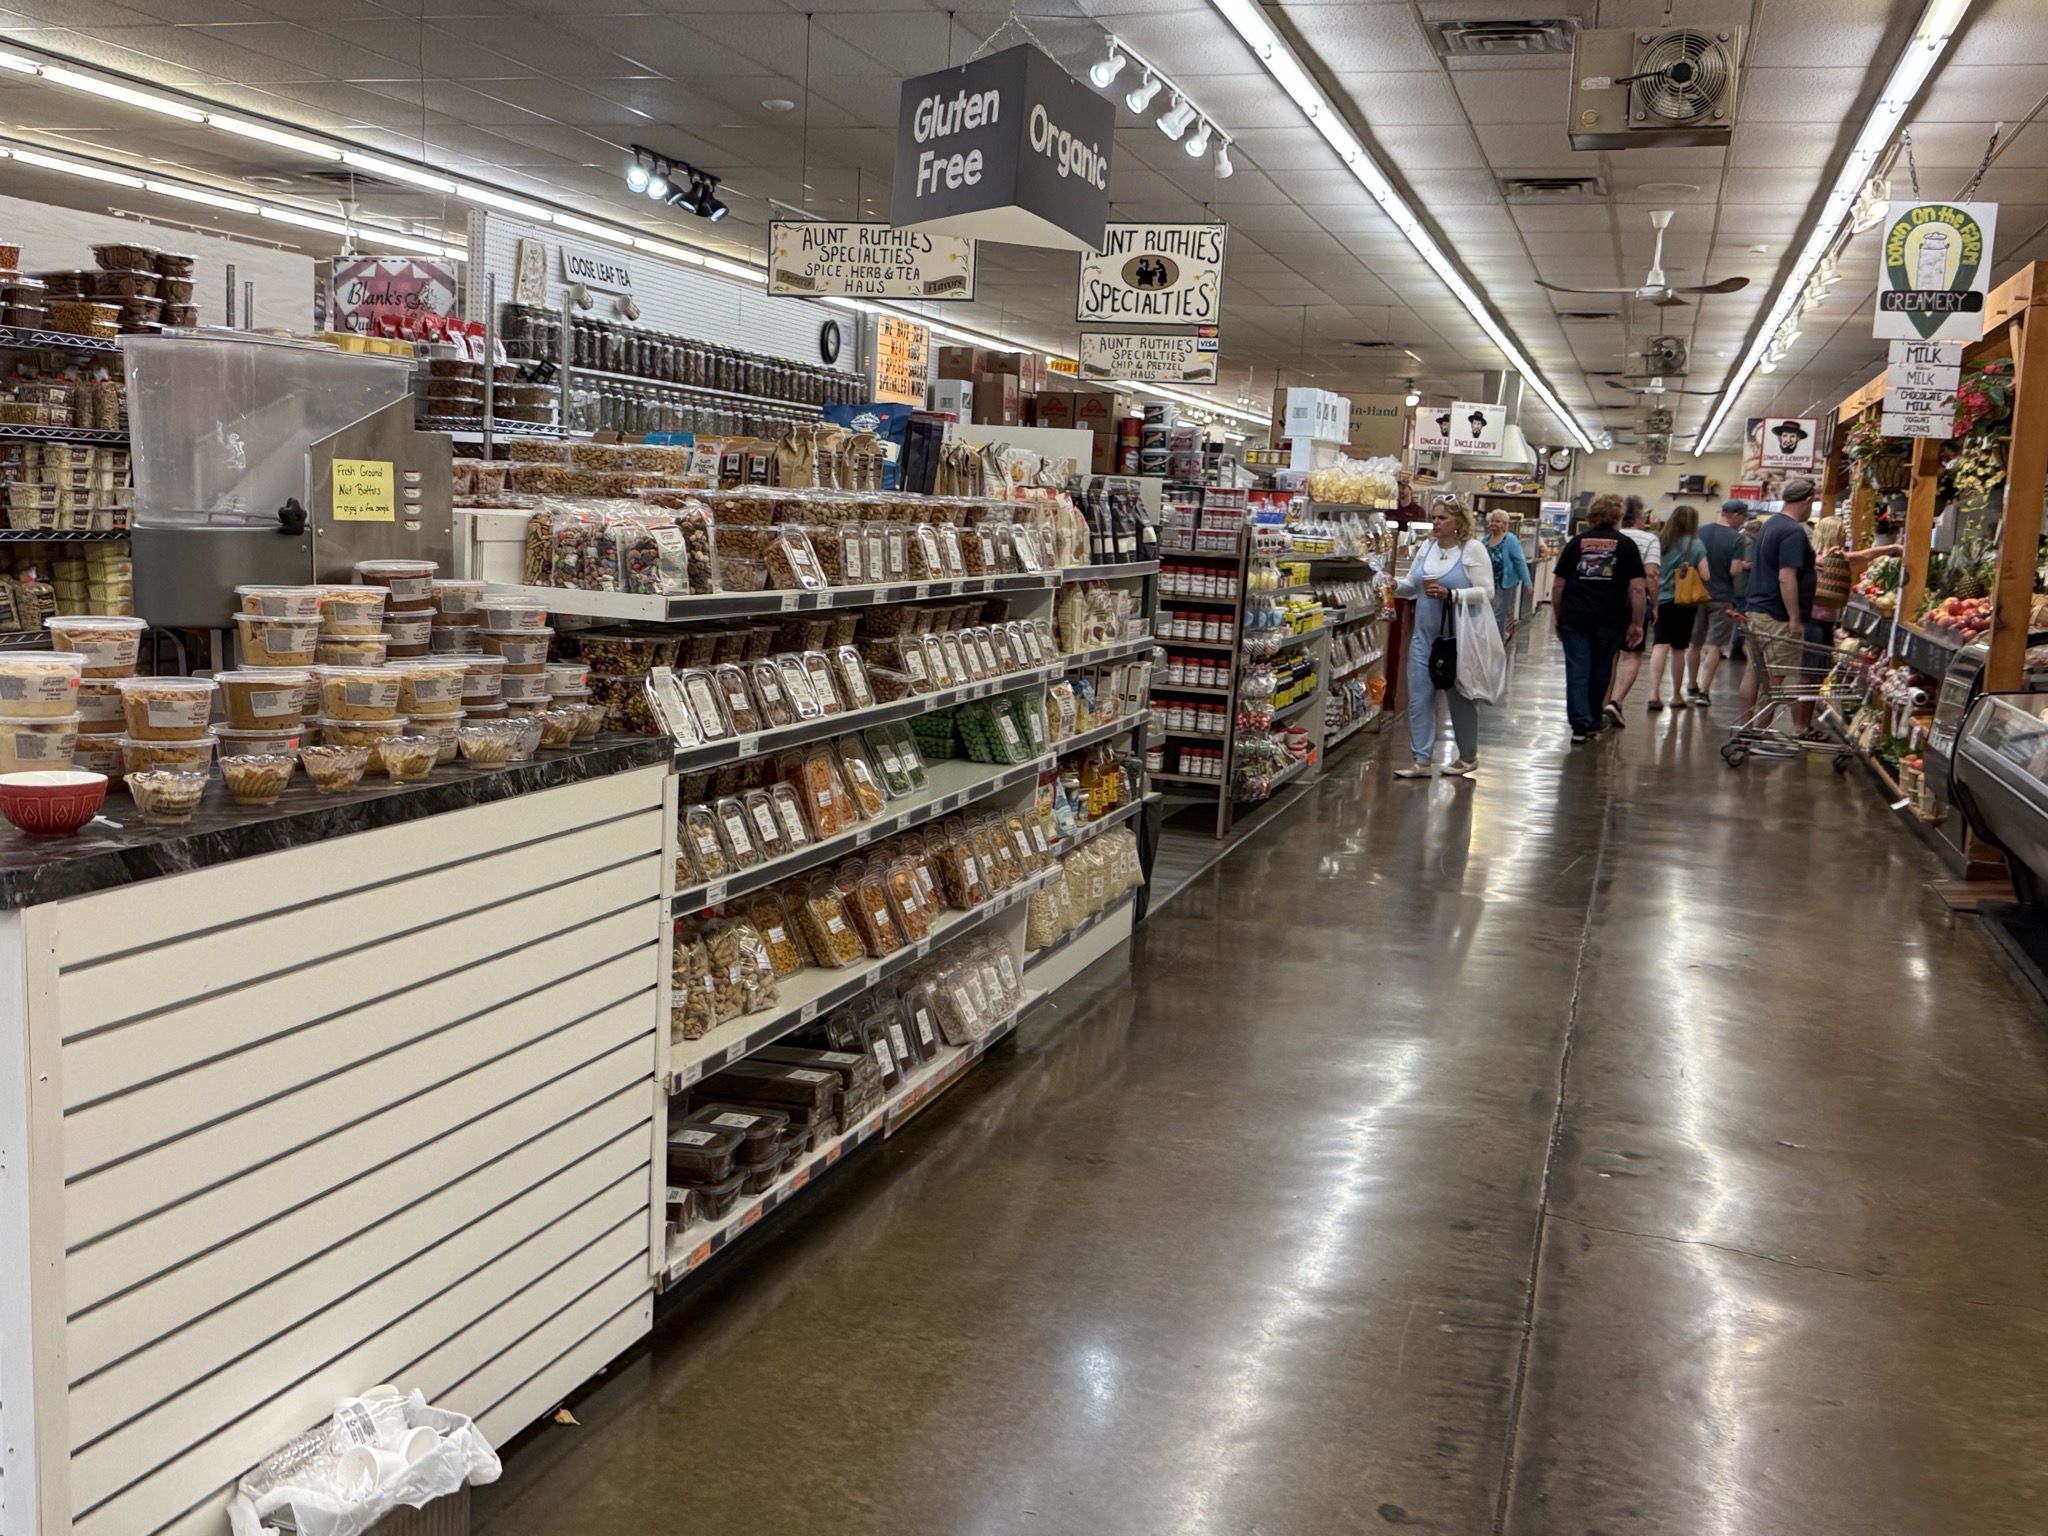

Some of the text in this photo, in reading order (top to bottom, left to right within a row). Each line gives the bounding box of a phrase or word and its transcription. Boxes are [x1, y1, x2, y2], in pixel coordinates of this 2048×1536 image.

[914, 89, 999, 143] Gluten
[1029, 103, 1108, 191] Organic
[916, 149, 983, 197] Free
[802, 227, 848, 251] AUNT
[1086, 230, 1139, 261] UNT
[819, 245, 914, 265] SPECIALTIES
[567, 253, 632, 288] LOOSE LEAF TEA
[884, 267, 894, 280] &
[896, 266, 920, 281] TEA
[347, 281, 403, 306] Blank's
[844, 281, 885, 294] HAUS
[1085, 279, 1210, 317] SPECIALTIES
[1886, 291, 1967, 311] CREAMERY
[1099, 337, 1132, 353] AUNT
[1200, 340, 1217, 348] VISA
[1111, 349, 1186, 363] SPECIALTIES
[1906, 347, 1942, 363] MILK
[1111, 360, 1183, 371] CHIP & PRETZEL
[1130, 370, 1156, 380] HAUS
[1906, 371, 1935, 386] MILK
[1900, 391, 1942, 401] CHOCOLATE
[1905, 401, 1932, 411] MILK
[1904, 416, 1930, 424] YOGURT
[1902, 424, 1930, 433] DRINKS
[1420, 437, 1443, 446] UNCLE
[1454, 439, 1472, 448] UNCLE
[1763, 454, 1810, 463] UNCLE LEROY'S
[337, 464, 383, 478] Fresh Ground
[1615, 464, 1641, 474] ICE
